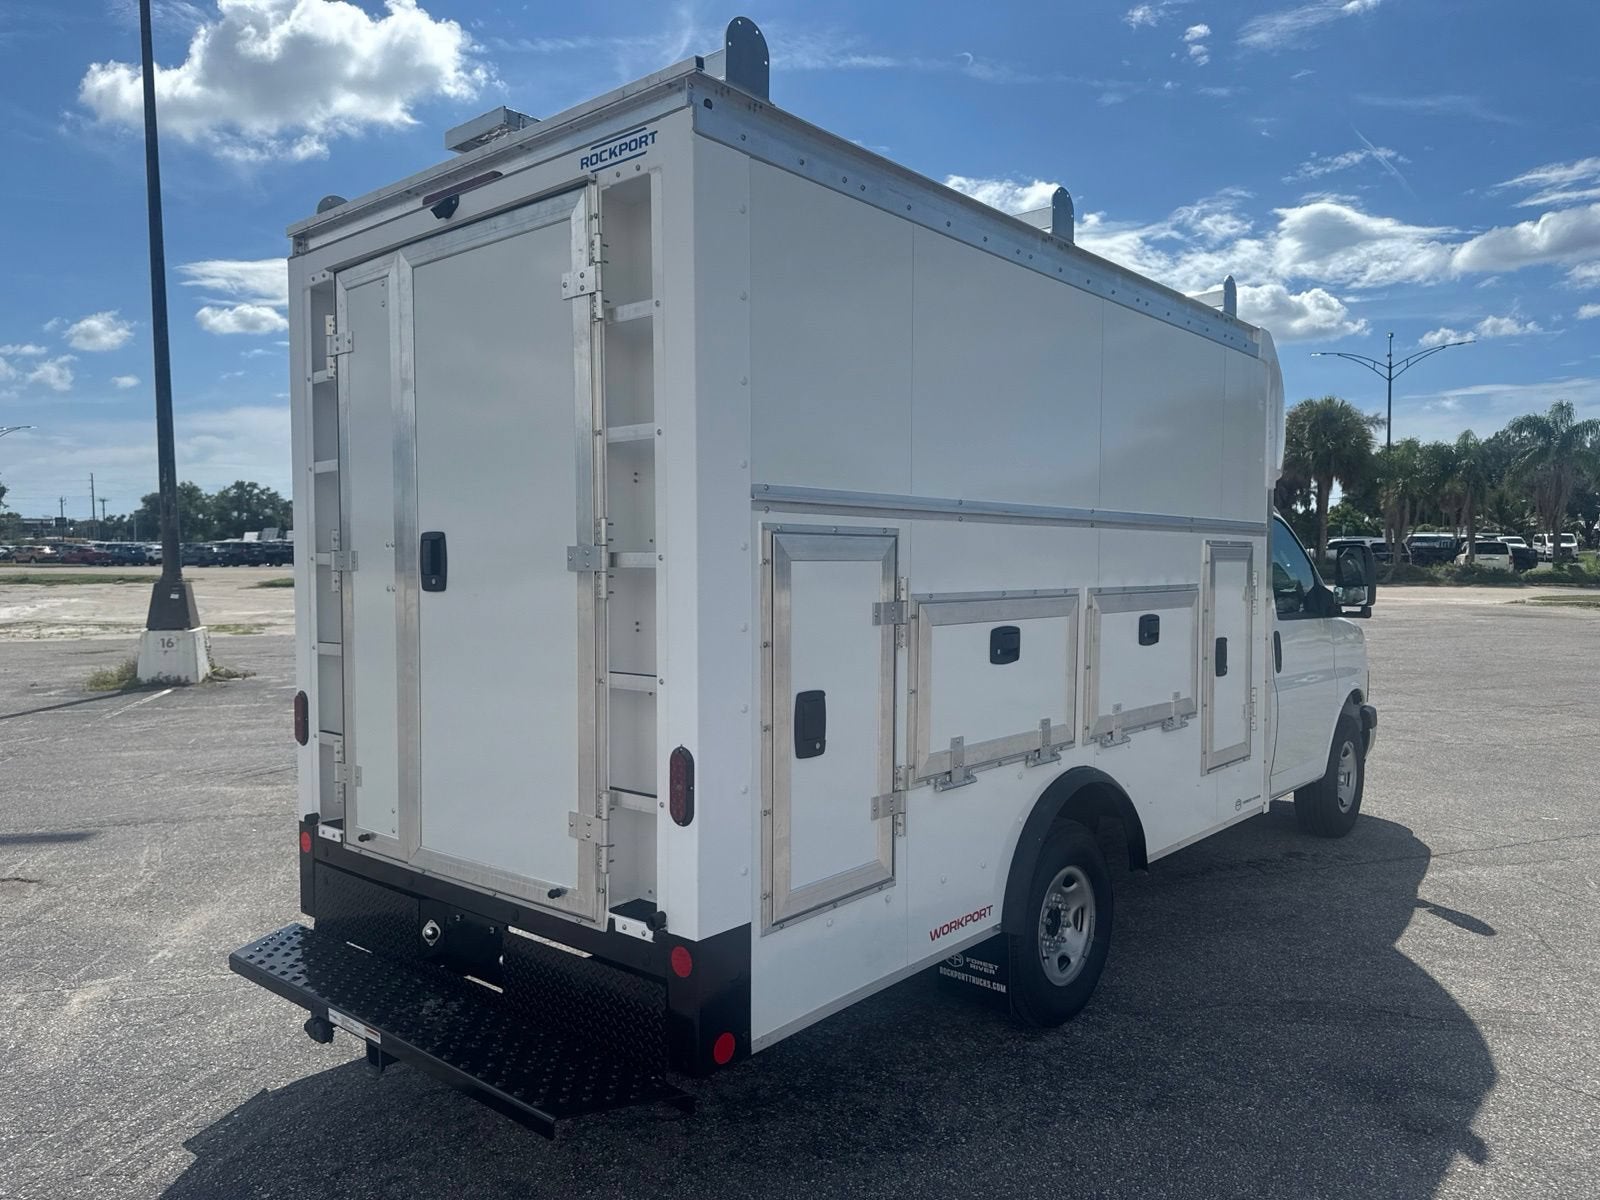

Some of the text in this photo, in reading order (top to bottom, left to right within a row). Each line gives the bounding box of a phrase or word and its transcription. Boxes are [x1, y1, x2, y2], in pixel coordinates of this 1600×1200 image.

[580, 130, 658, 170] ROCKPORT
[160, 638, 175, 649] 16
[929, 904, 994, 942] WORKPORT
[965, 957, 999, 971] FOREST
[969, 963, 996, 975] RIVER
[939, 966, 1007, 993] ROCKPORTTRUCKS.COM
